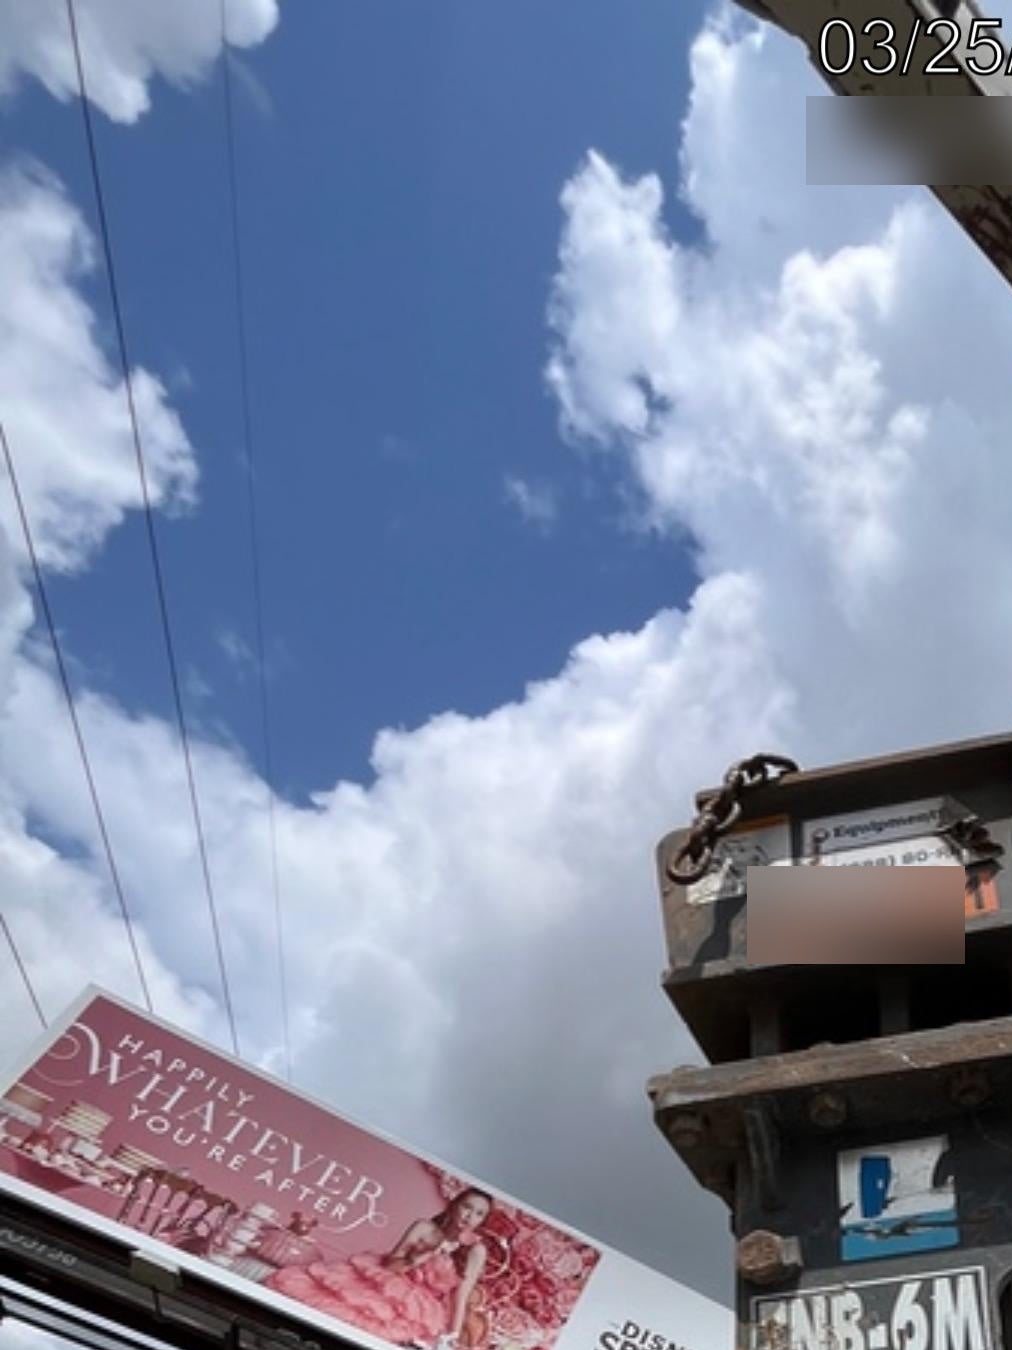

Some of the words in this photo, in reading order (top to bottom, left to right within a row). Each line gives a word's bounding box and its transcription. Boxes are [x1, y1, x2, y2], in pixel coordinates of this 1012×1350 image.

[72, 1021, 386, 1222] WHATEVER
[118, 1033, 254, 1108] HAPPILY
[128, 1104, 247, 1171] YOU'RE
[254, 1168, 349, 1220] AFTER
